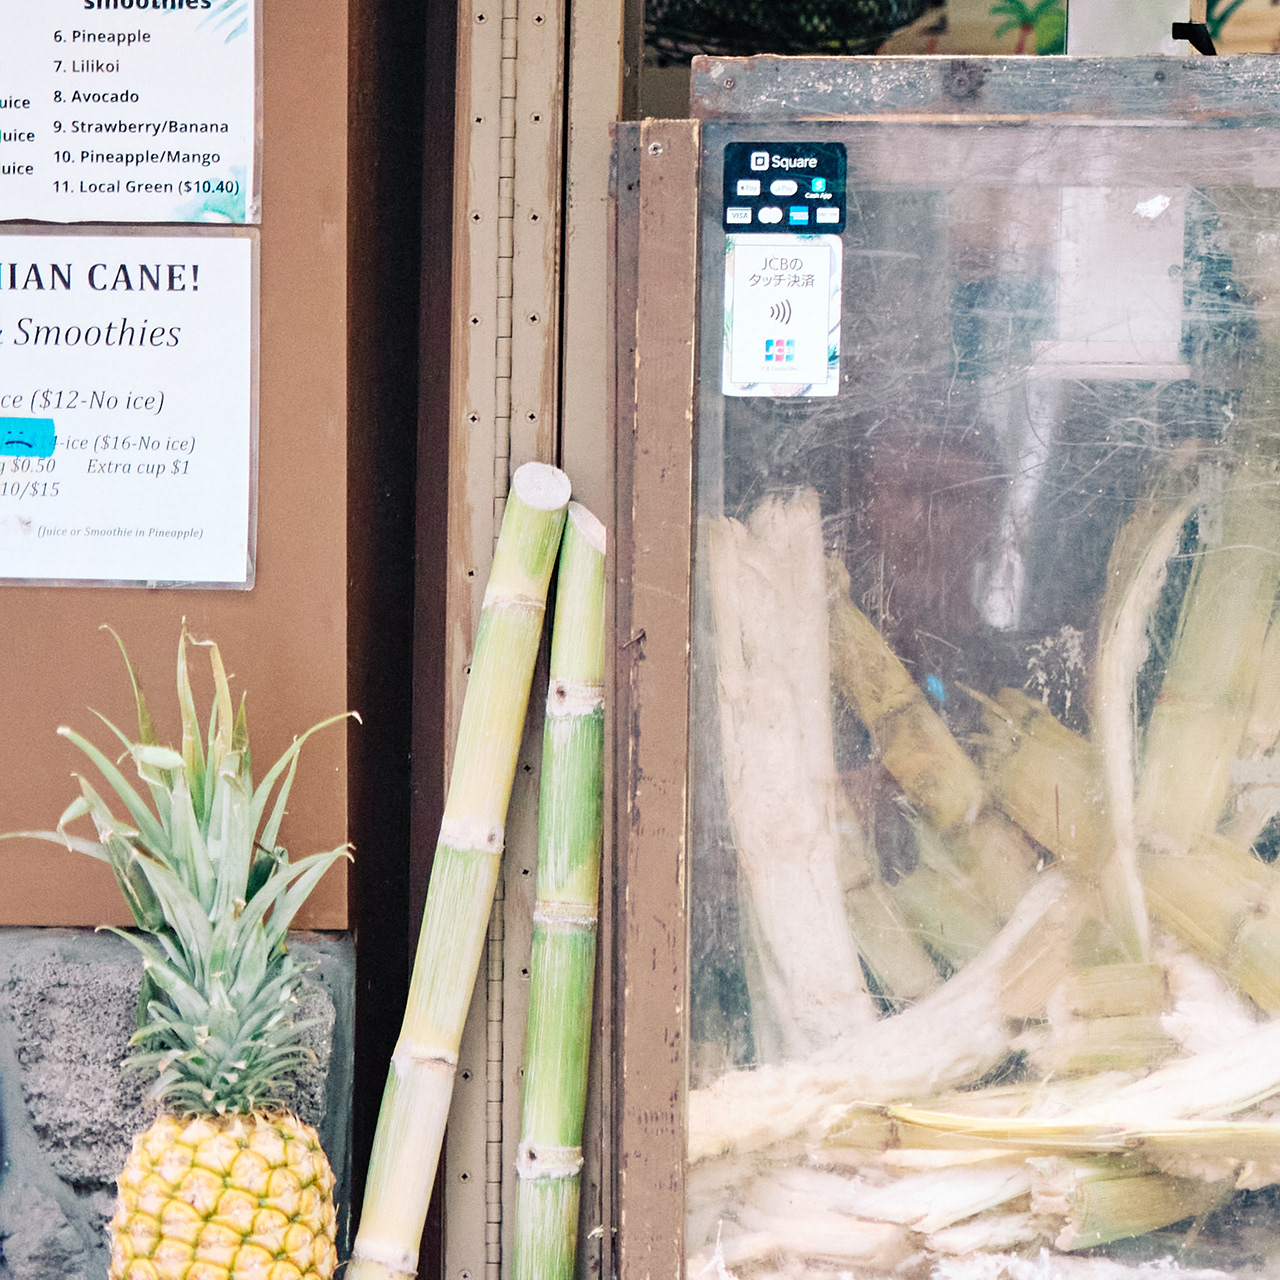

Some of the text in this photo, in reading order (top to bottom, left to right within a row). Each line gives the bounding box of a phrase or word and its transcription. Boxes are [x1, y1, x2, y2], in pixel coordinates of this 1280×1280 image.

[53, 30, 151, 47] 6. Pineapple
[53, 60, 120, 73] 7. Lilikoi
[53, 90, 140, 104] 8. Avocado
[53, 120, 229, 137] 9. Strawberry/Banana
[53, 150, 221, 167] 10. Pineapple/Mango
[771, 155, 818, 170] Square
[53, 180, 240, 196] 11. Local Green ($10.40)
[761, 257, 804, 271] JCBの
[0, 263, 199, 291] IAN CANE!
[749, 274, 815, 288] タッチ決済
[13, 317, 181, 347] Smoothies
[30, 389, 118, 415] ($12-No
[126, 390, 165, 416] ice)
[93, 434, 161, 455] ($16-No
[165, 436, 197, 456] ice)
[11, 457, 56, 474] $0.50
[87, 458, 131, 474] Extra
[137, 461, 166, 479] cup
[170, 459, 190, 475] $1
[37, 525, 204, 540] (Juice or Smoothie in Pineapple)
